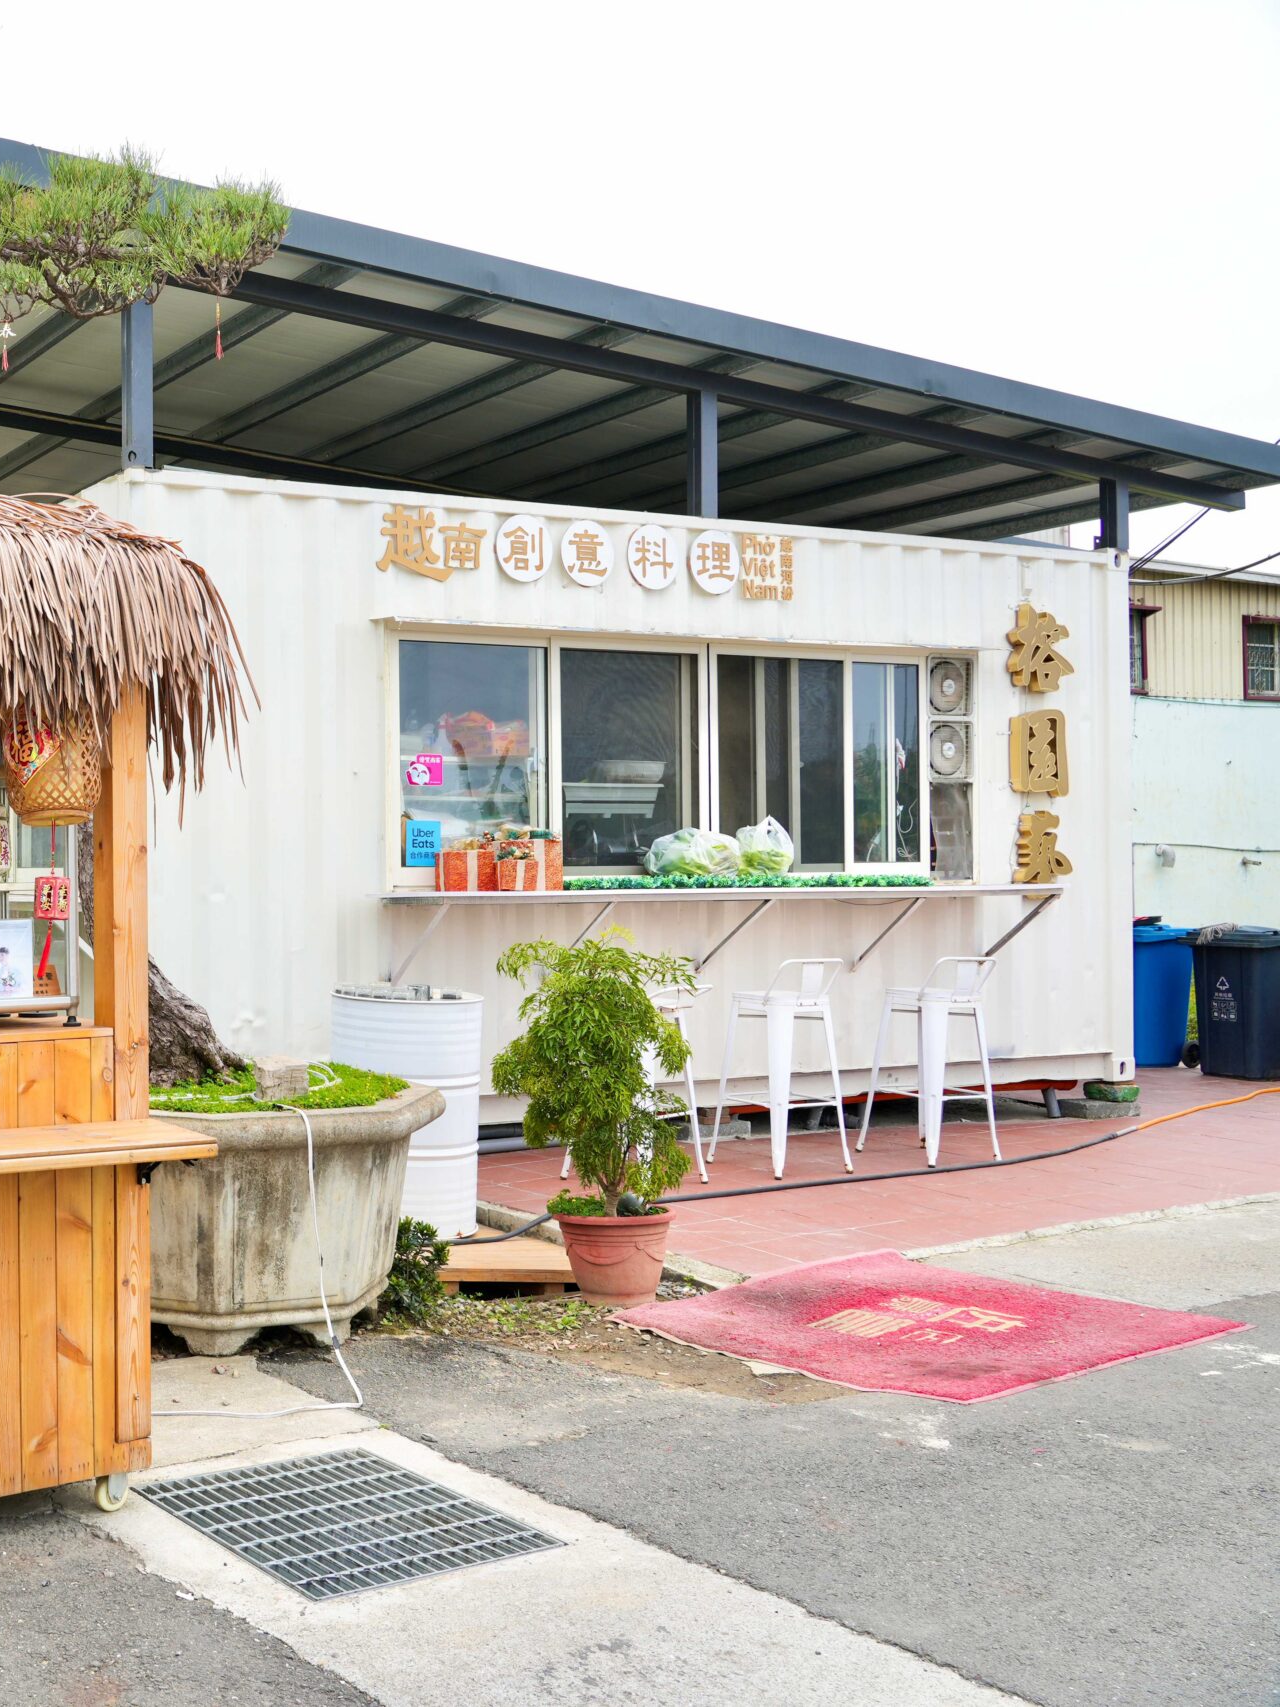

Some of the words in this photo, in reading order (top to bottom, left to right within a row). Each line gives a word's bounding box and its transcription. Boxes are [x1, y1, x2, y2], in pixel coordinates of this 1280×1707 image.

[376, 504, 735, 582] 越南創意料理
[742, 557, 776, 582] Việt
[780, 537, 793, 600] 越南河粉
[742, 579, 778, 600] Nam
[412, 828, 434, 838] Uber
[412, 839, 435, 849] Eats
